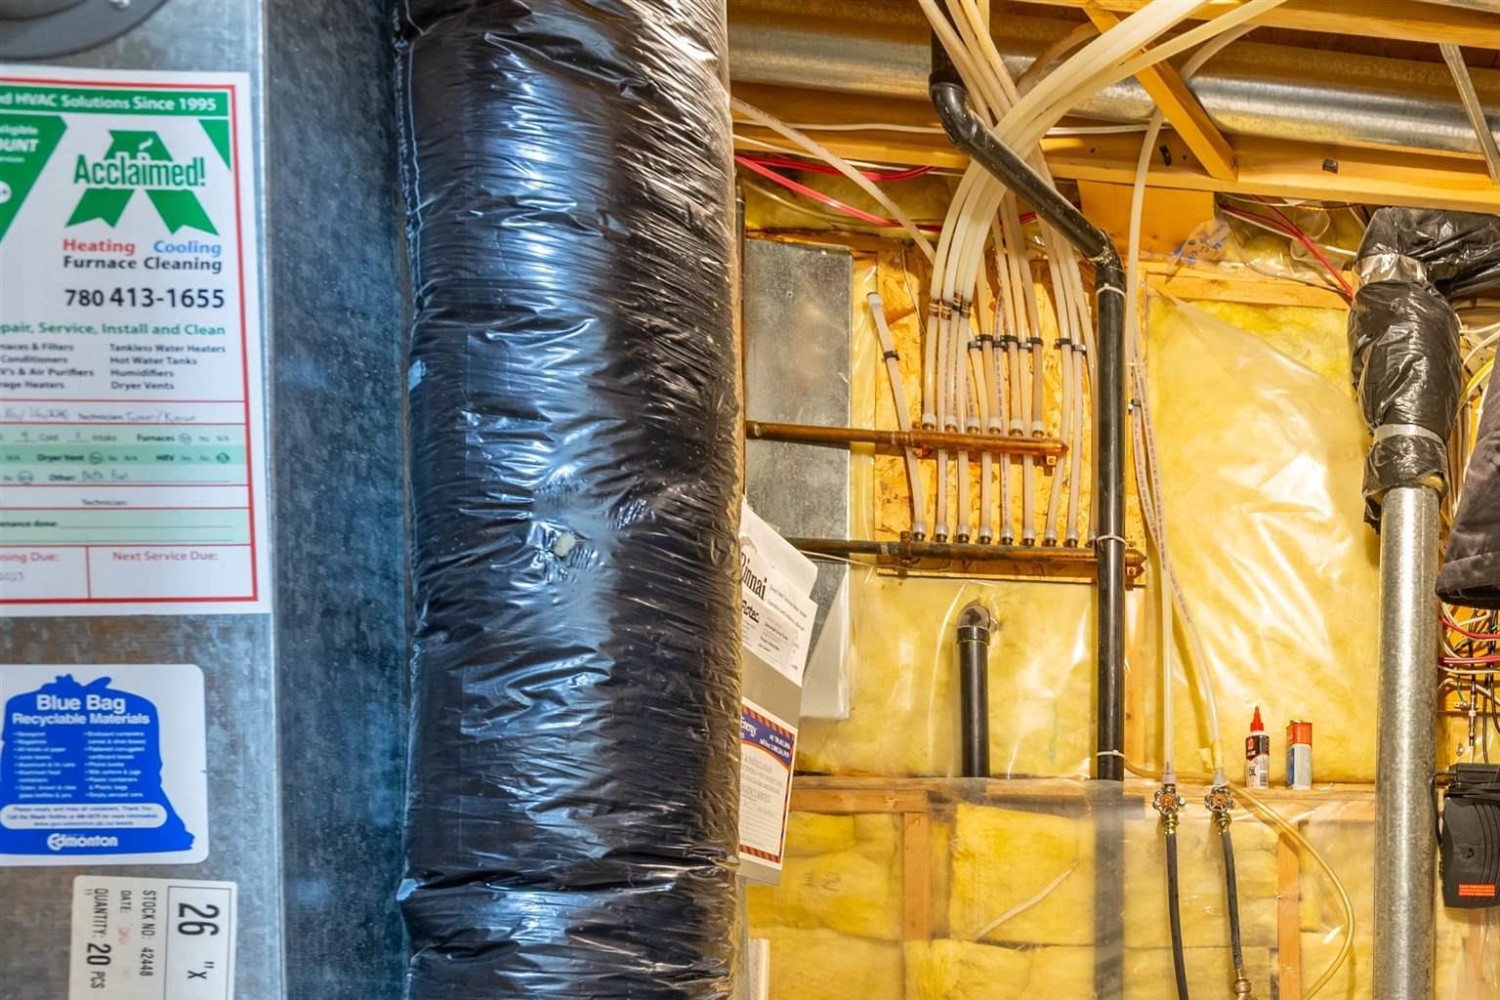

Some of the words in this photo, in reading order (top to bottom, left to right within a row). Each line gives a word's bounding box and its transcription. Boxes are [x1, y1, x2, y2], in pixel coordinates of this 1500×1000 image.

[15, 92, 58, 108] HVAC
[60, 94, 131, 110] Solutions
[132, 96, 176, 112] Since
[178, 97, 218, 112] 1995
[74, 153, 206, 187] Acclaimed!
[63, 238, 136, 256] Heating
[153, 240, 222, 257] Cooling
[63, 255, 137, 270] Furnace
[144, 256, 223, 275] Cleaning
[65, 288, 105, 308] 780
[110, 286, 226, 309] 413-1655
[102, 324, 149, 336] Install
[151, 324, 183, 336] and
[184, 325, 226, 337] Clean
[110, 356, 131, 366] Hot
[30, 551, 61, 563] Due:
[112, 550, 143, 561] Next
[144, 550, 188, 562] Service
[190, 550, 220, 562] Due:
[36, 694, 82, 712] Blue
[86, 694, 127, 715] Bag
[12, 712, 87, 728] Recyclable
[89, 712, 151, 725] Materials
[140, 889, 158, 920] STOCK
[176, 902, 221, 937] 26
[86, 942, 113, 967] 20
[90, 970, 107, 991] PCS
